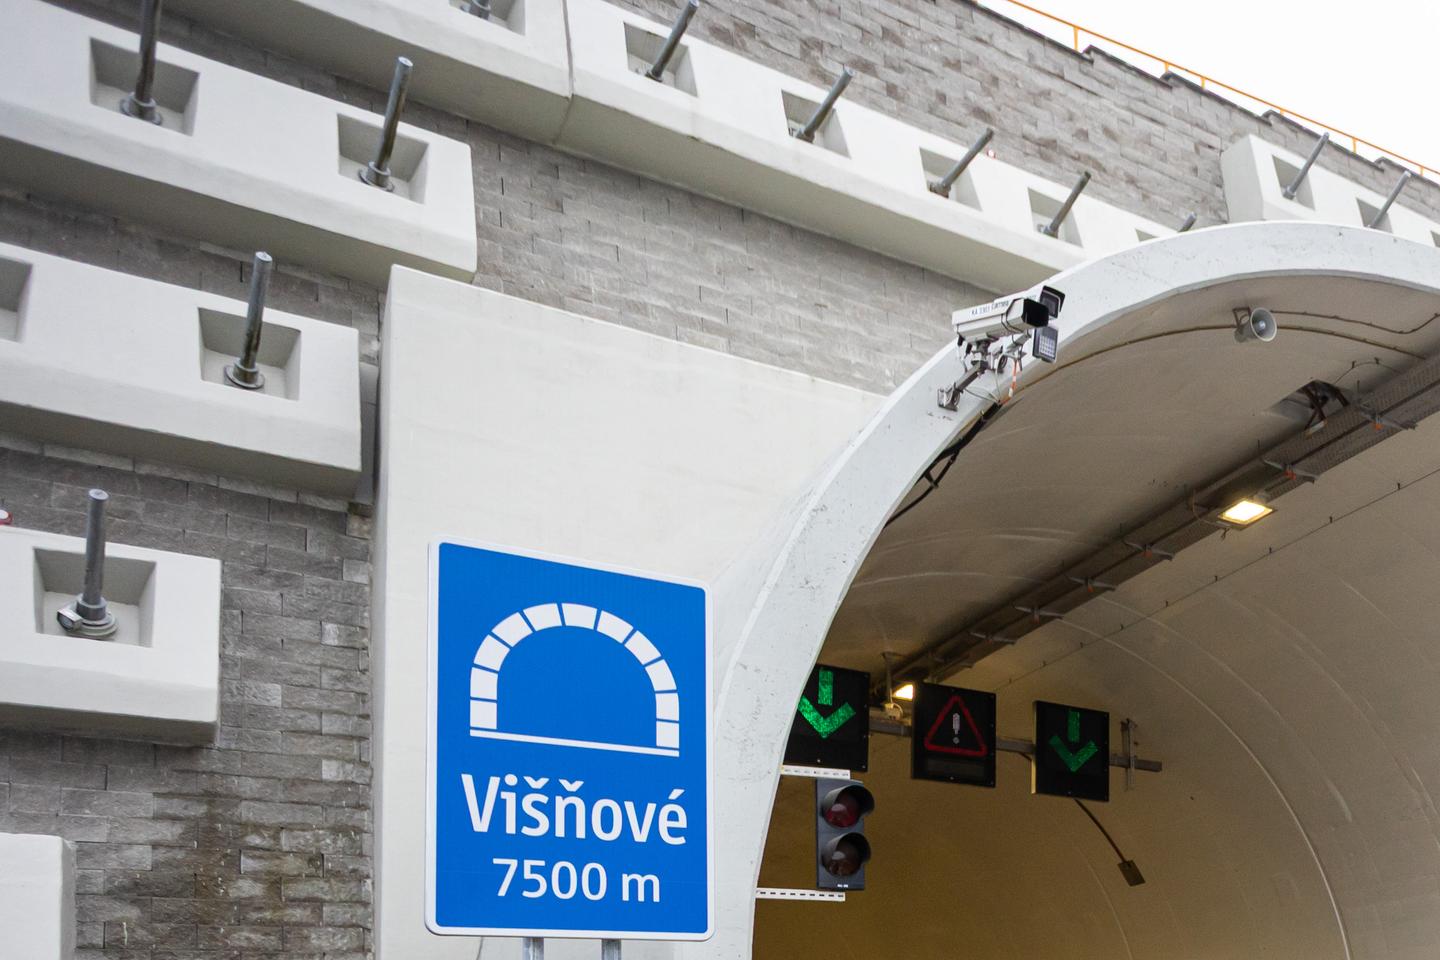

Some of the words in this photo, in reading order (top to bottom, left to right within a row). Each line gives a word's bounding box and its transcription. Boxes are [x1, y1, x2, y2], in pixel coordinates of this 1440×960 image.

[461, 773, 688, 845] Višňové
[492, 858, 608, 900] 7500
[621, 873, 661, 902] m
